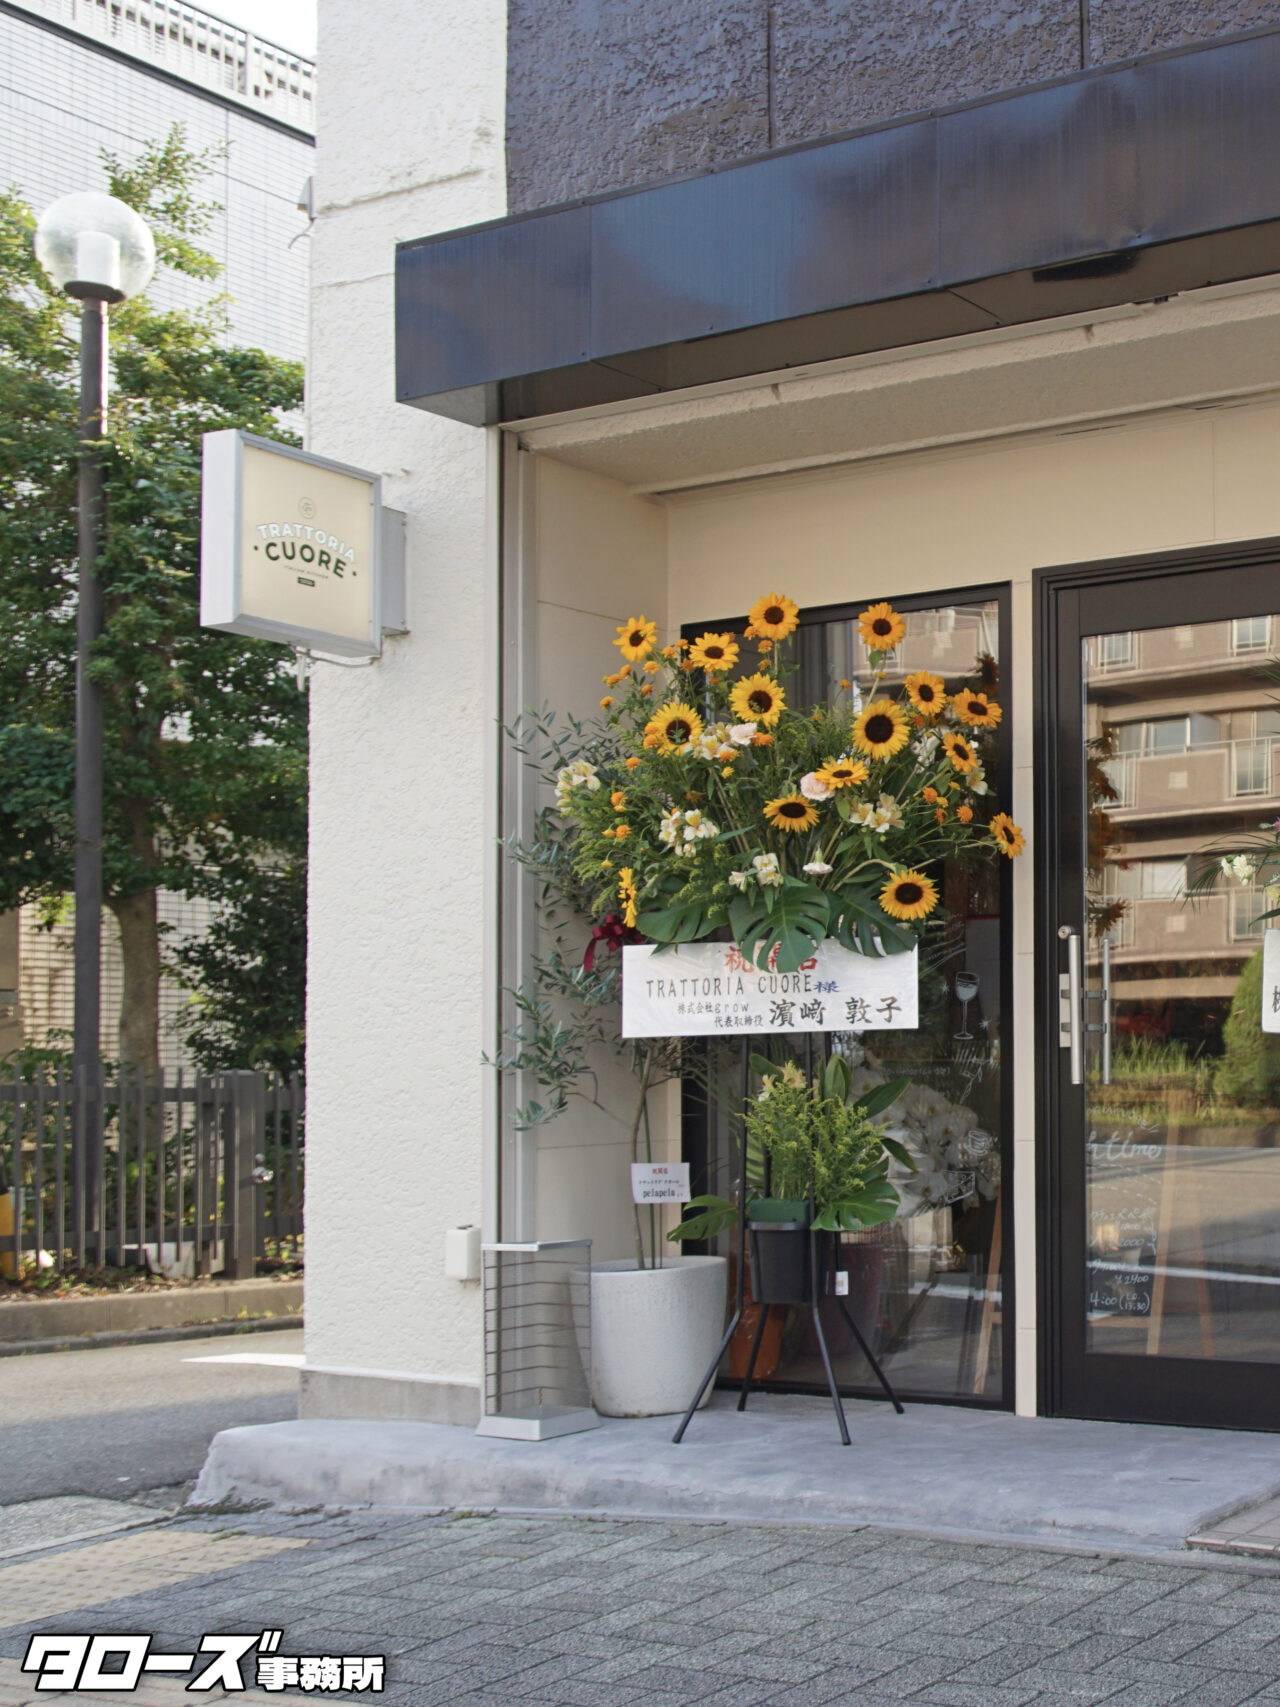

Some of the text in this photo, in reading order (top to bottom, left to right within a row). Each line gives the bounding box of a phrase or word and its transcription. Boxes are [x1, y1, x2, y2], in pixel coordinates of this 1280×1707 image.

[256, 522, 356, 563] TRATTORIA
[265, 541, 347, 578] CUORE
[646, 976, 744, 998] TRATTORIA
[643, 1187, 675, 1198] pelapela
